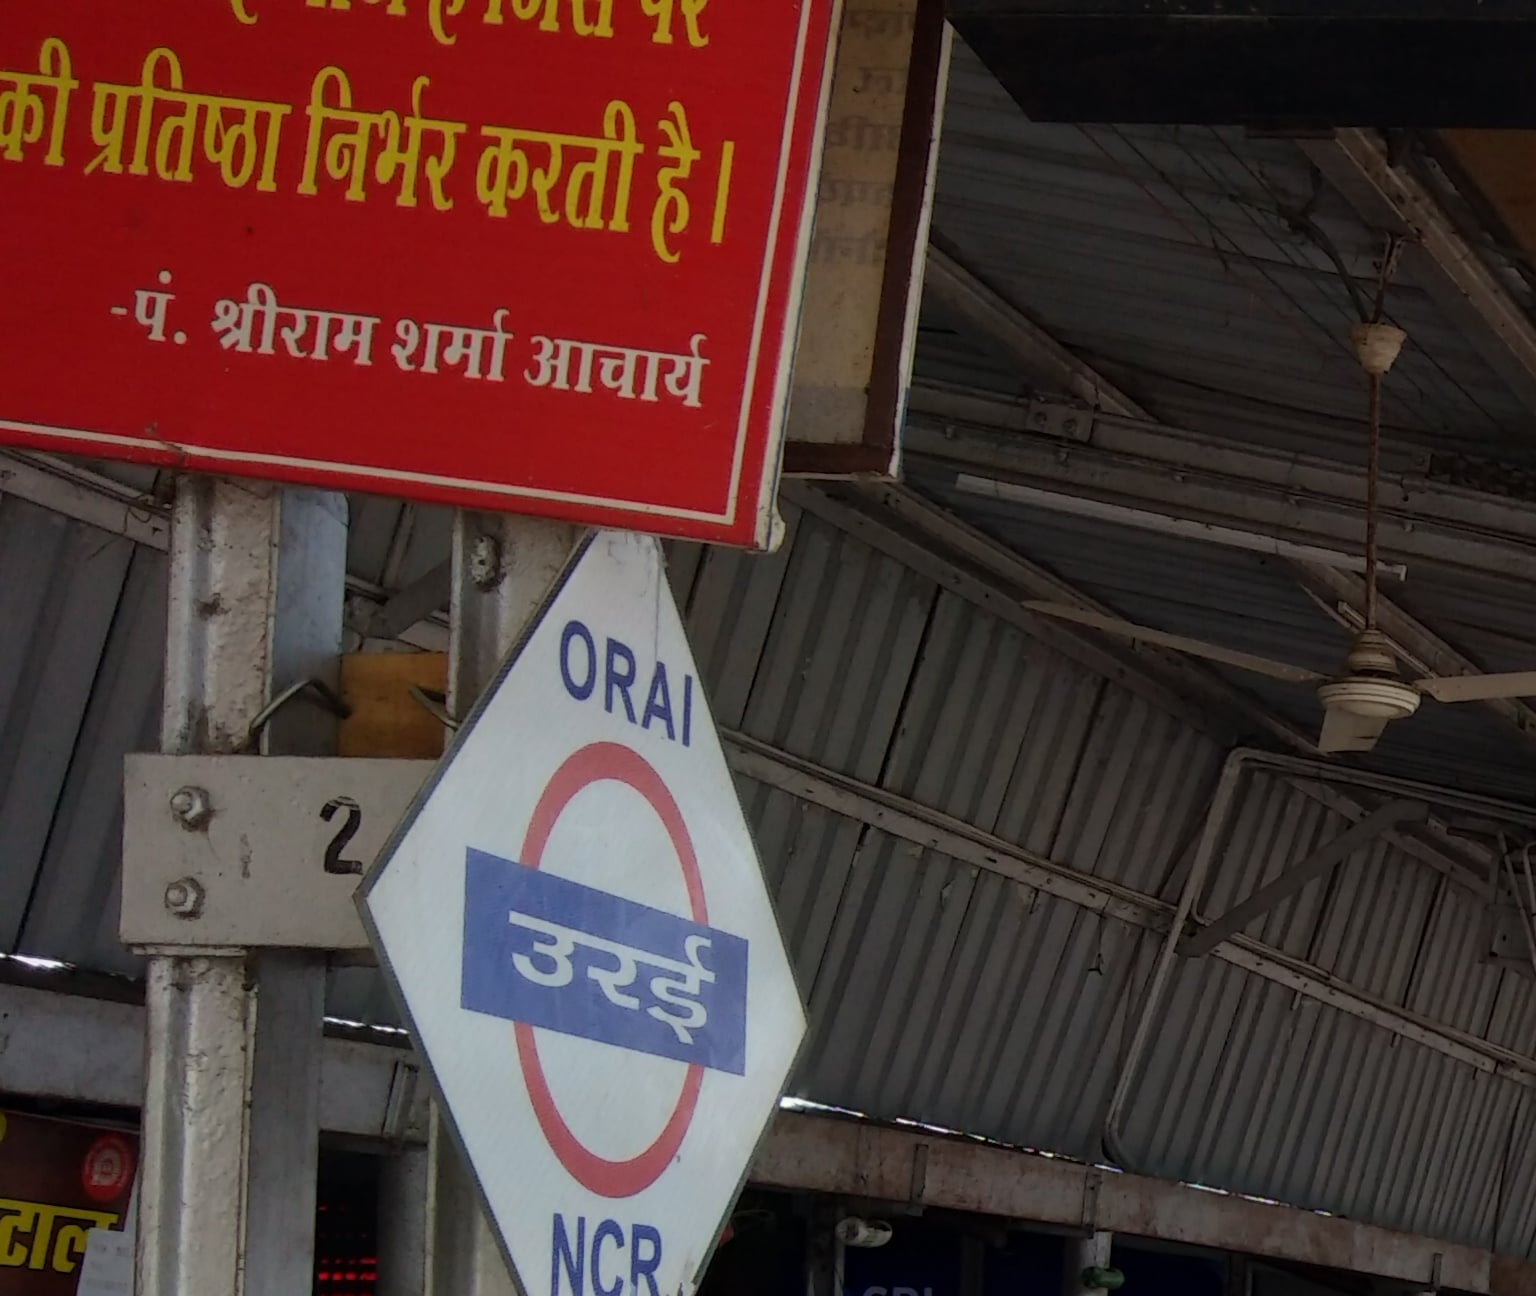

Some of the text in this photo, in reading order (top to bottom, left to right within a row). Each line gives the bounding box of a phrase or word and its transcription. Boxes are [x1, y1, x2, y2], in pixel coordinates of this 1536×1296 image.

[84, 47, 292, 192] प्रतिष्ठा
[297, 66, 467, 212] निर्भर
[475, 100, 644, 233] करती
[211, 283, 380, 367] श्रीराम
[391, 309, 515, 383] शर्मा
[524, 333, 709, 408] आचार्य
[559, 620, 693, 747] ORAI
[320, 796, 362, 874] 2
[508, 911, 716, 1045] उरई
